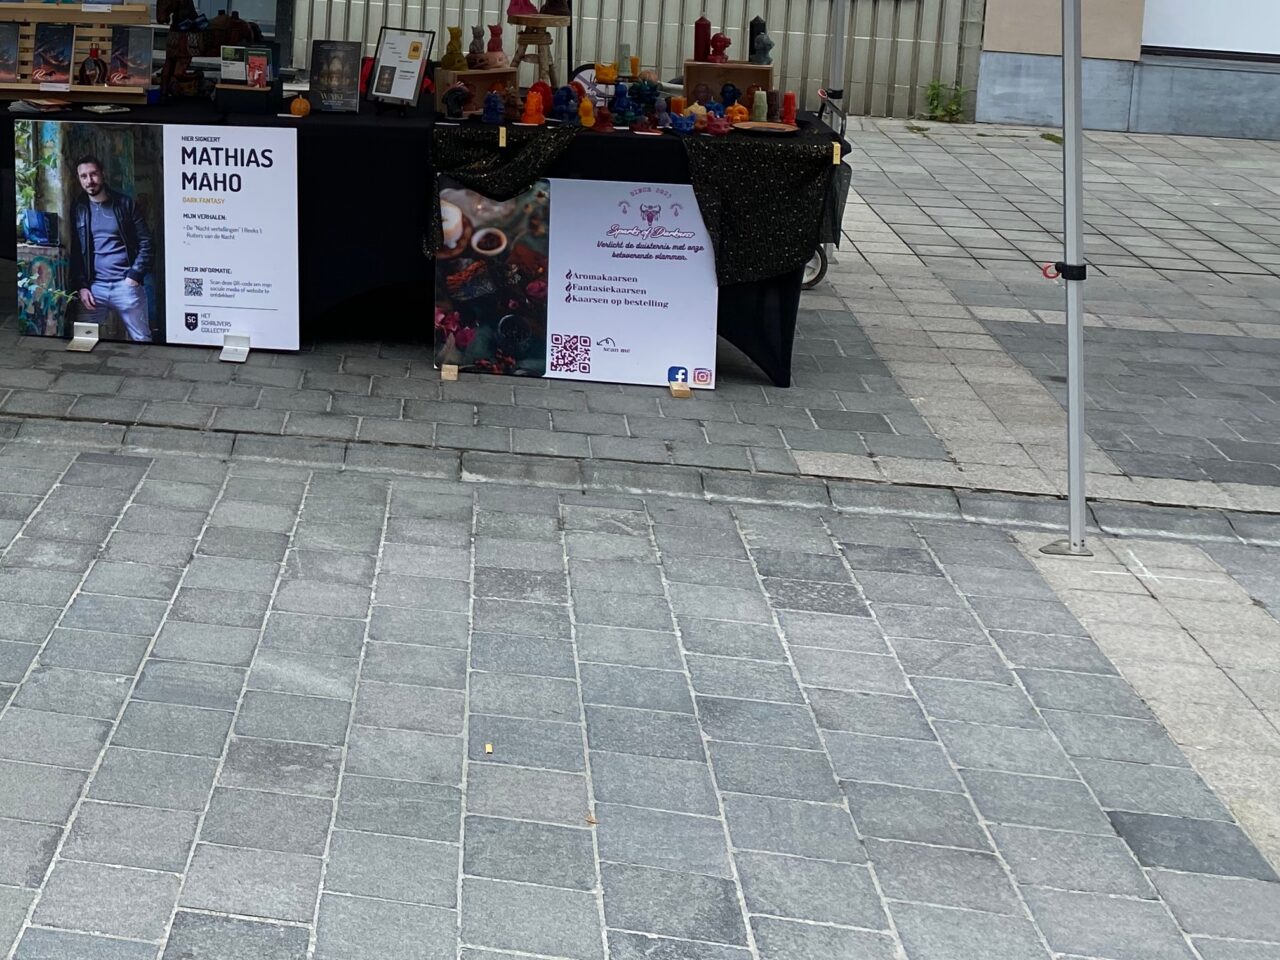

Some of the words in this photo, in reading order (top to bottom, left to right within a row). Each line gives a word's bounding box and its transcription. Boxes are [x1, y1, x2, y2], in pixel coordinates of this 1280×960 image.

[181, 145, 273, 168] MATHIAS
[181, 171, 242, 193] MAHO
[199, 197, 225, 205] FANTASY
[597, 240, 624, 248] Verlicht
[573, 272, 638, 282] Aromakaarsen
[572, 284, 647, 295] Fantasiekaarsen
[572, 295, 609, 304] Kaarsen
[624, 299, 669, 308] bestelling
[187, 315, 196, 323] SC
